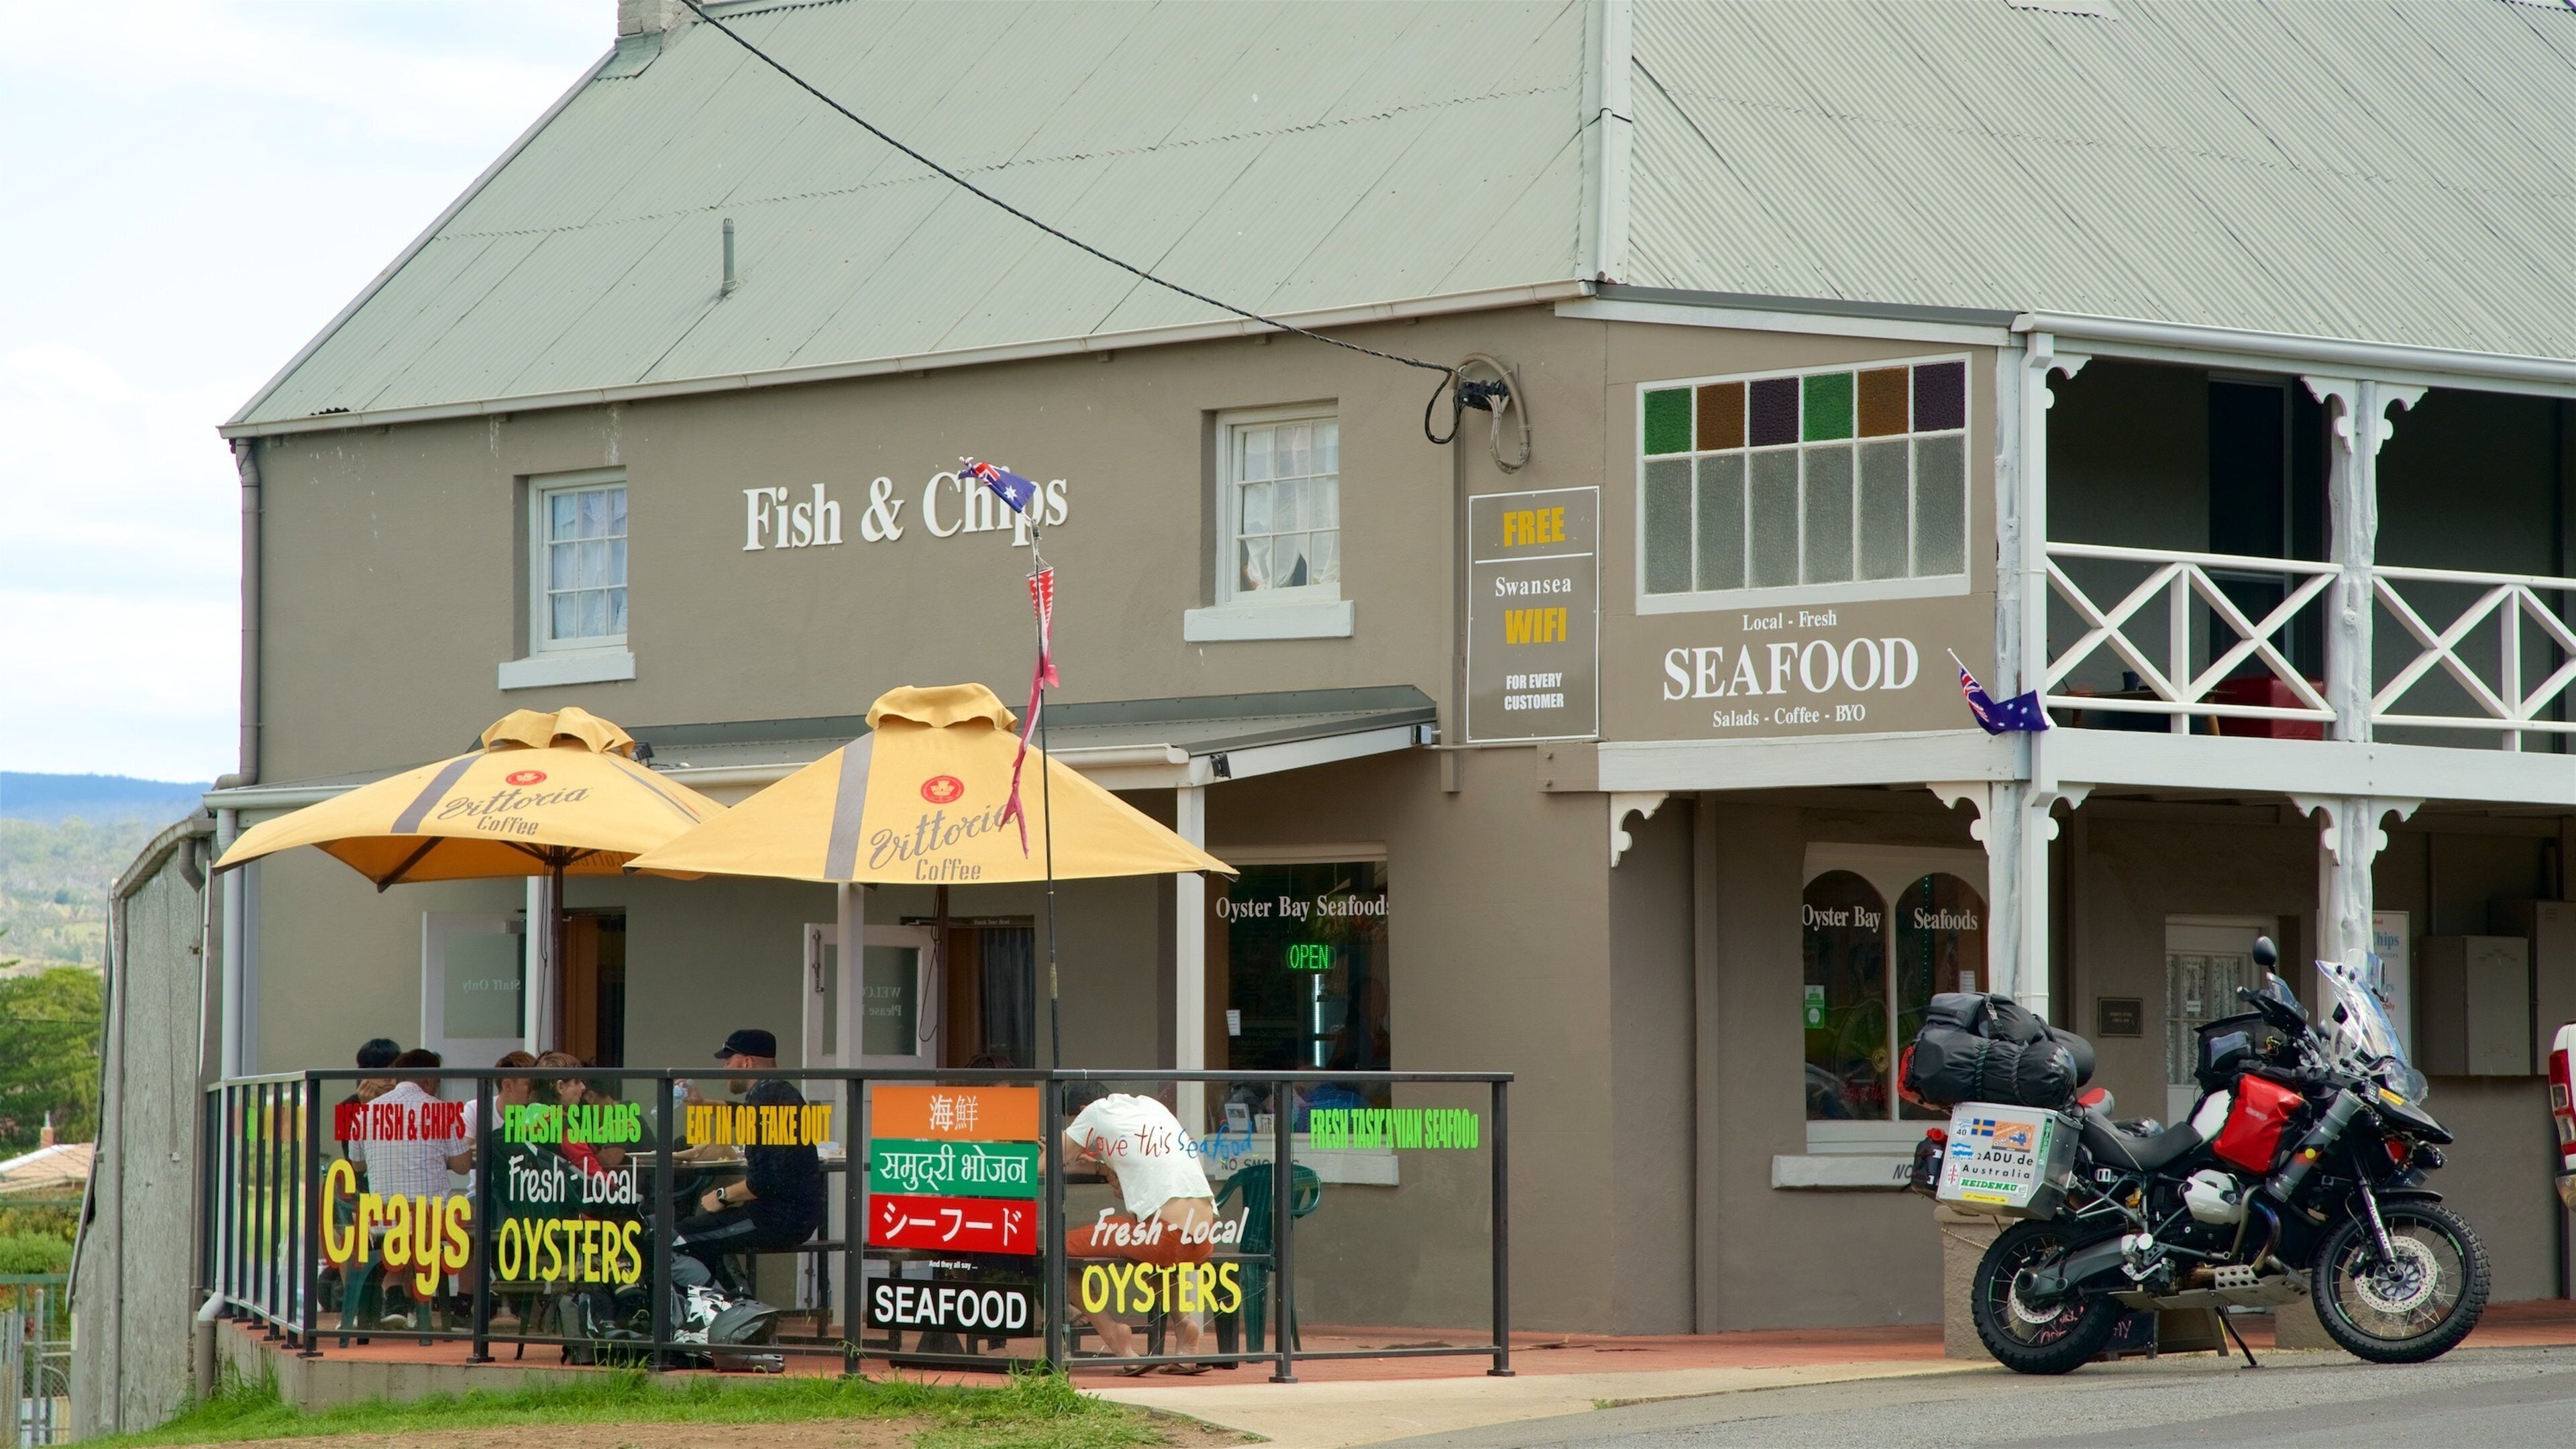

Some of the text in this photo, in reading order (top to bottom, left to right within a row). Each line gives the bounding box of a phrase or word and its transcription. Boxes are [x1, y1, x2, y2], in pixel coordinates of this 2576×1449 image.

[743, 483, 843, 550] Fish
[861, 476, 904, 542] &
[1504, 506, 1565, 547] FREE
[1495, 576, 1572, 597] Swansea
[1505, 607, 1567, 644] WIFI
[1743, 612, 1783, 631] Local
[1799, 609, 1837, 627] Fresh
[1506, 672, 1562, 690] FOR EVERY
[1664, 637, 1919, 701] SEAFOOD
[1504, 693, 1564, 710] CUSTOMER
[1713, 709, 1760, 728] Salads
[1774, 706, 1820, 724] Coffee
[1835, 704, 1866, 722] BYO
[476, 815, 539, 836] Coffee
[915, 858, 982, 881] Coffee
[1216, 896, 1273, 923] Oyster
[1279, 896, 1310, 922] Bay
[1802, 904, 1978, 932] Oyster Bay Seafoods
[2374, 932, 2400, 950] hips
[1289, 945, 1329, 969] OPEN
[334, 1103, 369, 1141] BEST
[373, 1103, 403, 1141] FISH
[407, 1109, 417, 1140] &
[421, 1102, 466, 1140] CHIPS
[505, 1103, 641, 1144] FRESH SALADS
[686, 1105, 832, 1146] EAT IN OR TAKE OUT
[929, 1094, 979, 1132] 海鮮
[1310, 1108, 1348, 1149] FRESH
[1425, 1108, 1479, 1149] SEAFOOD
[1085, 1127, 1128, 1158] Love
[961, 1144, 1029, 1184] भोजन
[1893, 1164, 1913, 1179] NO
[1963, 1165, 2030, 1179] Australia
[1961, 1179, 2018, 1191] HEIDENAU
[323, 1159, 472, 1299] Crays
[883, 1202, 1022, 1246] シーフード
[498, 1217, 642, 1285] OYSTERS
[941, 1260, 953, 1270] they
[961, 1263, 971, 1271] say
[1081, 1262, 1242, 1313] OYSTERS
[874, 1285, 1027, 1330] SEAFOOD
